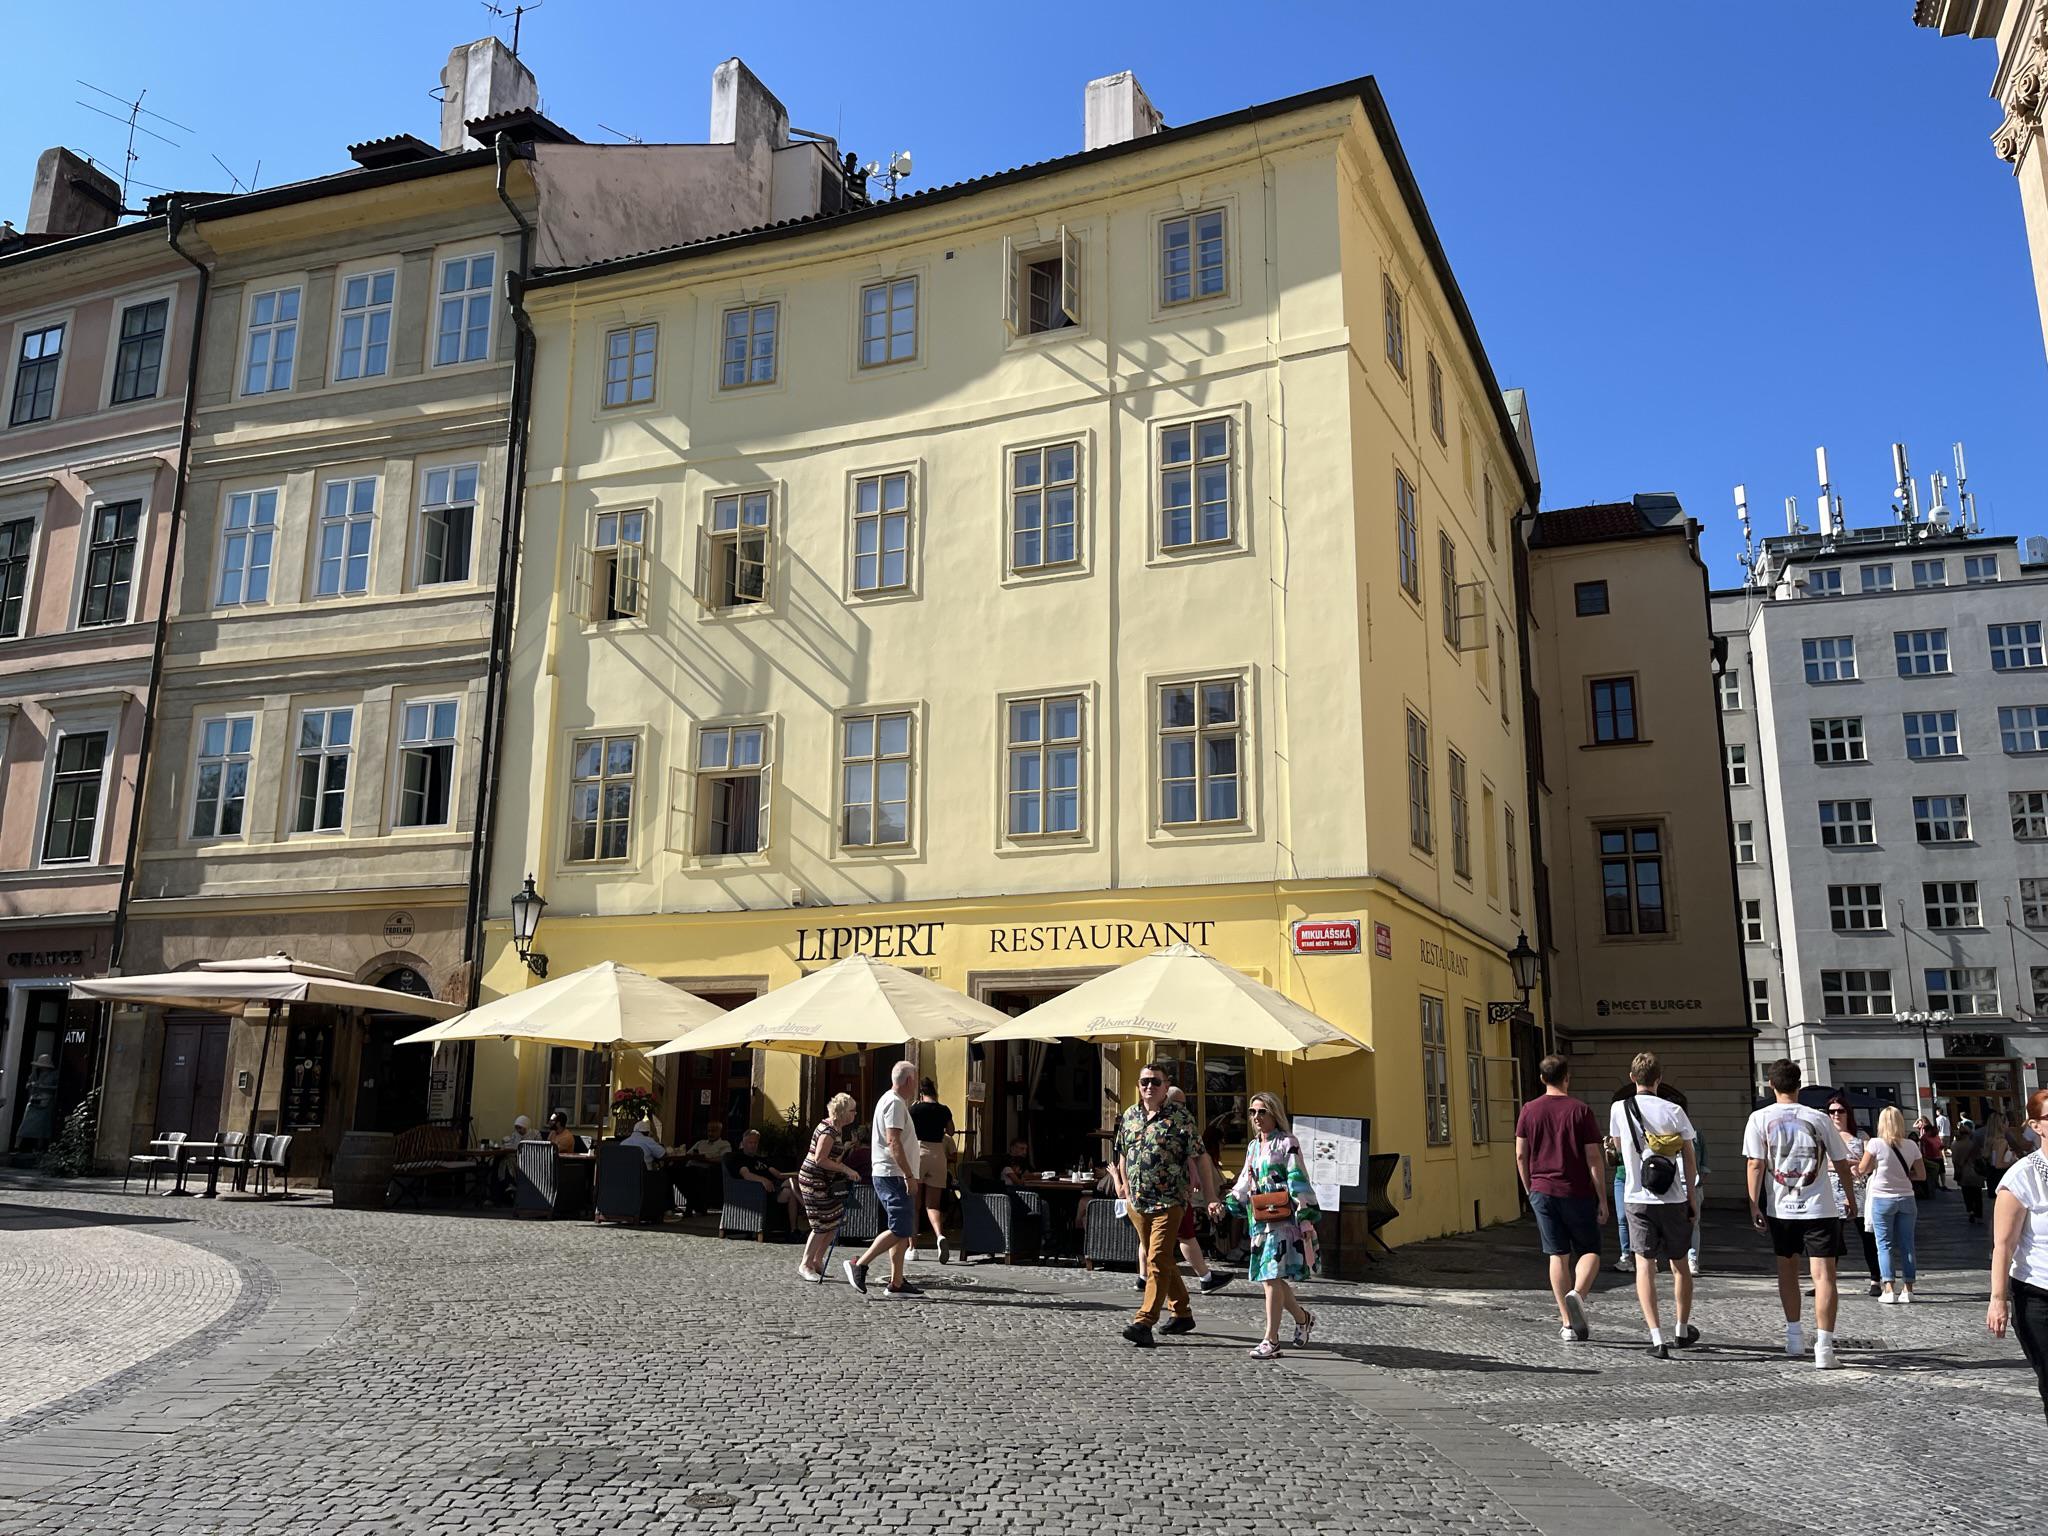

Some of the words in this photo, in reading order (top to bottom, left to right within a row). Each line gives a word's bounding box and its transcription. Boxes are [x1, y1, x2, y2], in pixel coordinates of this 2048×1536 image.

[1301, 927, 1351, 940] MIKULÁŠSKÁ
[794, 921, 945, 962] LIPPERT
[989, 920, 1216, 953] RESTAURANT
[1420, 938, 1469, 978] RESTAURANT
[1611, 999, 1647, 1010] MEET
[1649, 999, 1703, 1010] BURGER
[1086, 1016, 1134, 1032] Pilsner
[1133, 1016, 1177, 1032] Urquell
[64, 1031, 86, 1043] ATM
